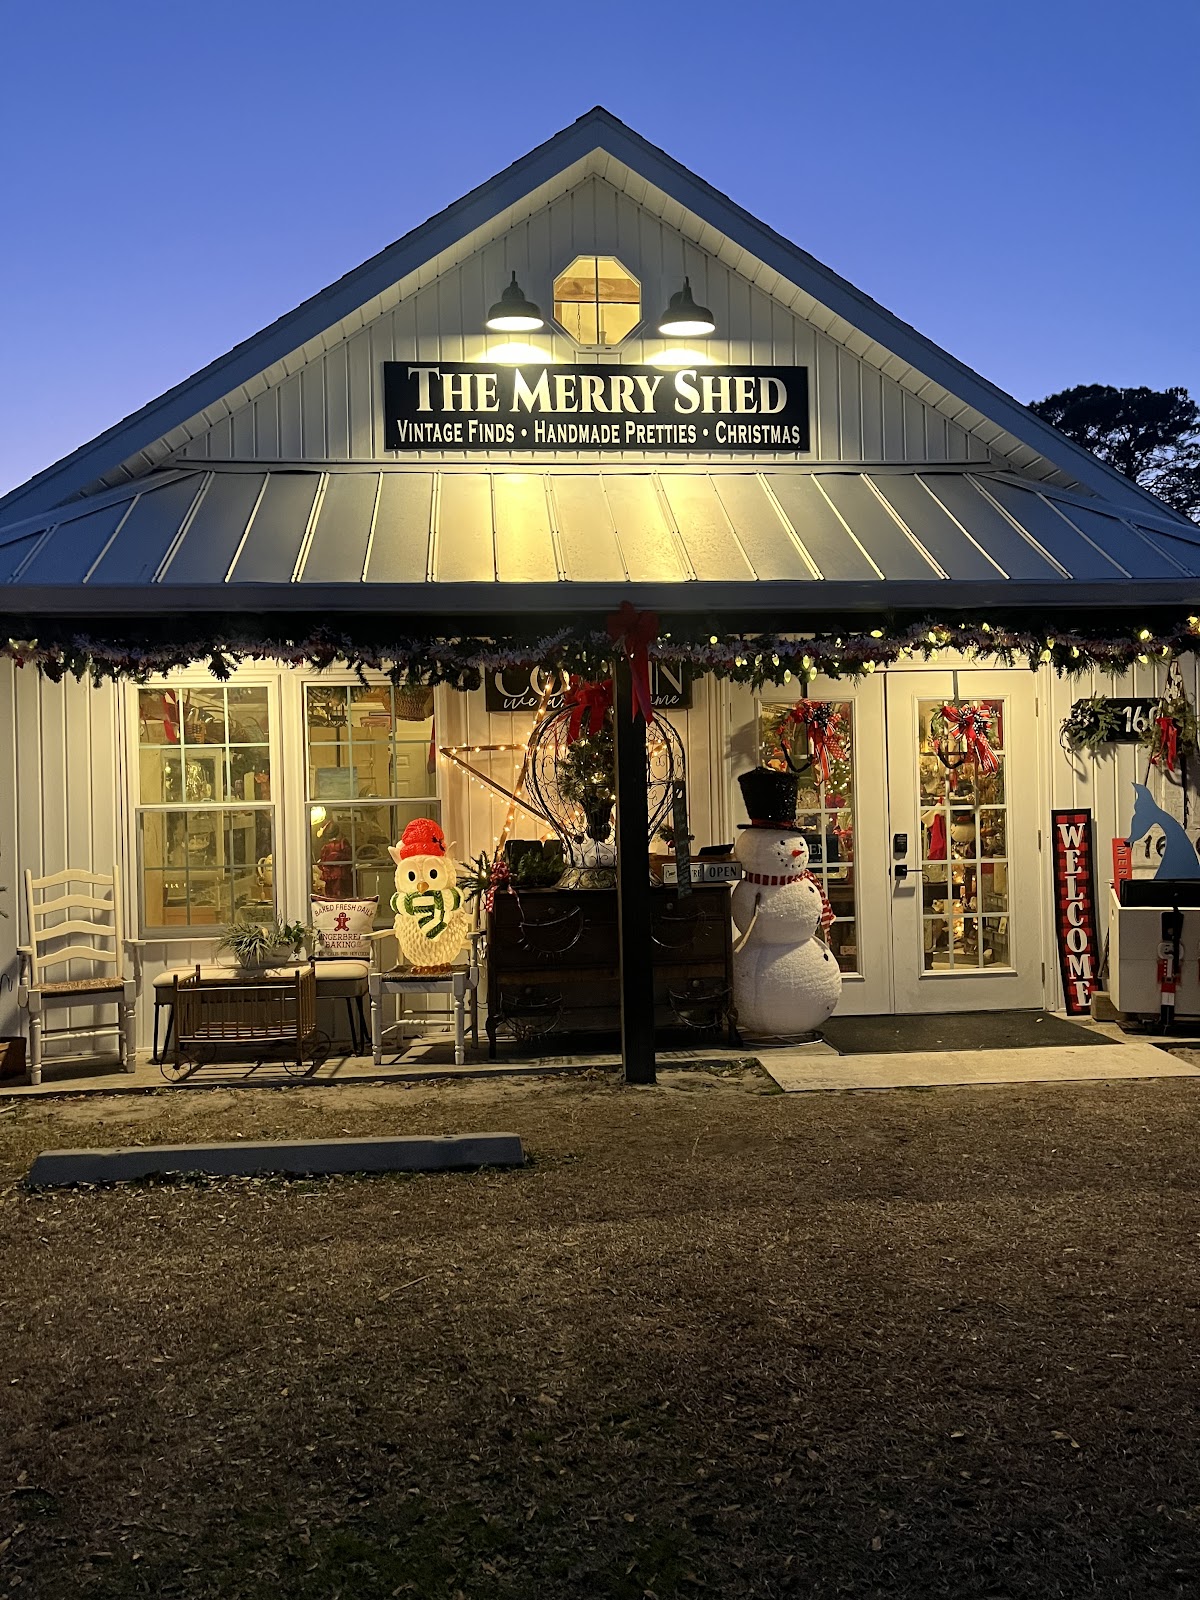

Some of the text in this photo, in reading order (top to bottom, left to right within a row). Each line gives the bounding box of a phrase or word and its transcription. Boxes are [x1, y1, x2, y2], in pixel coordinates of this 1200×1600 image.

[407, 366, 787, 414] THE MERRY SHED
[397, 418, 800, 445] VINTAGE FINDS HANDMADE PRETTIES CHRISTMAS
[709, 866, 737, 878] OPEN
[1116, 845, 1128, 880] MER
[314, 903, 374, 917] BAKED FRESH DAILY
[1056, 823, 1093, 1007] WELCOME
